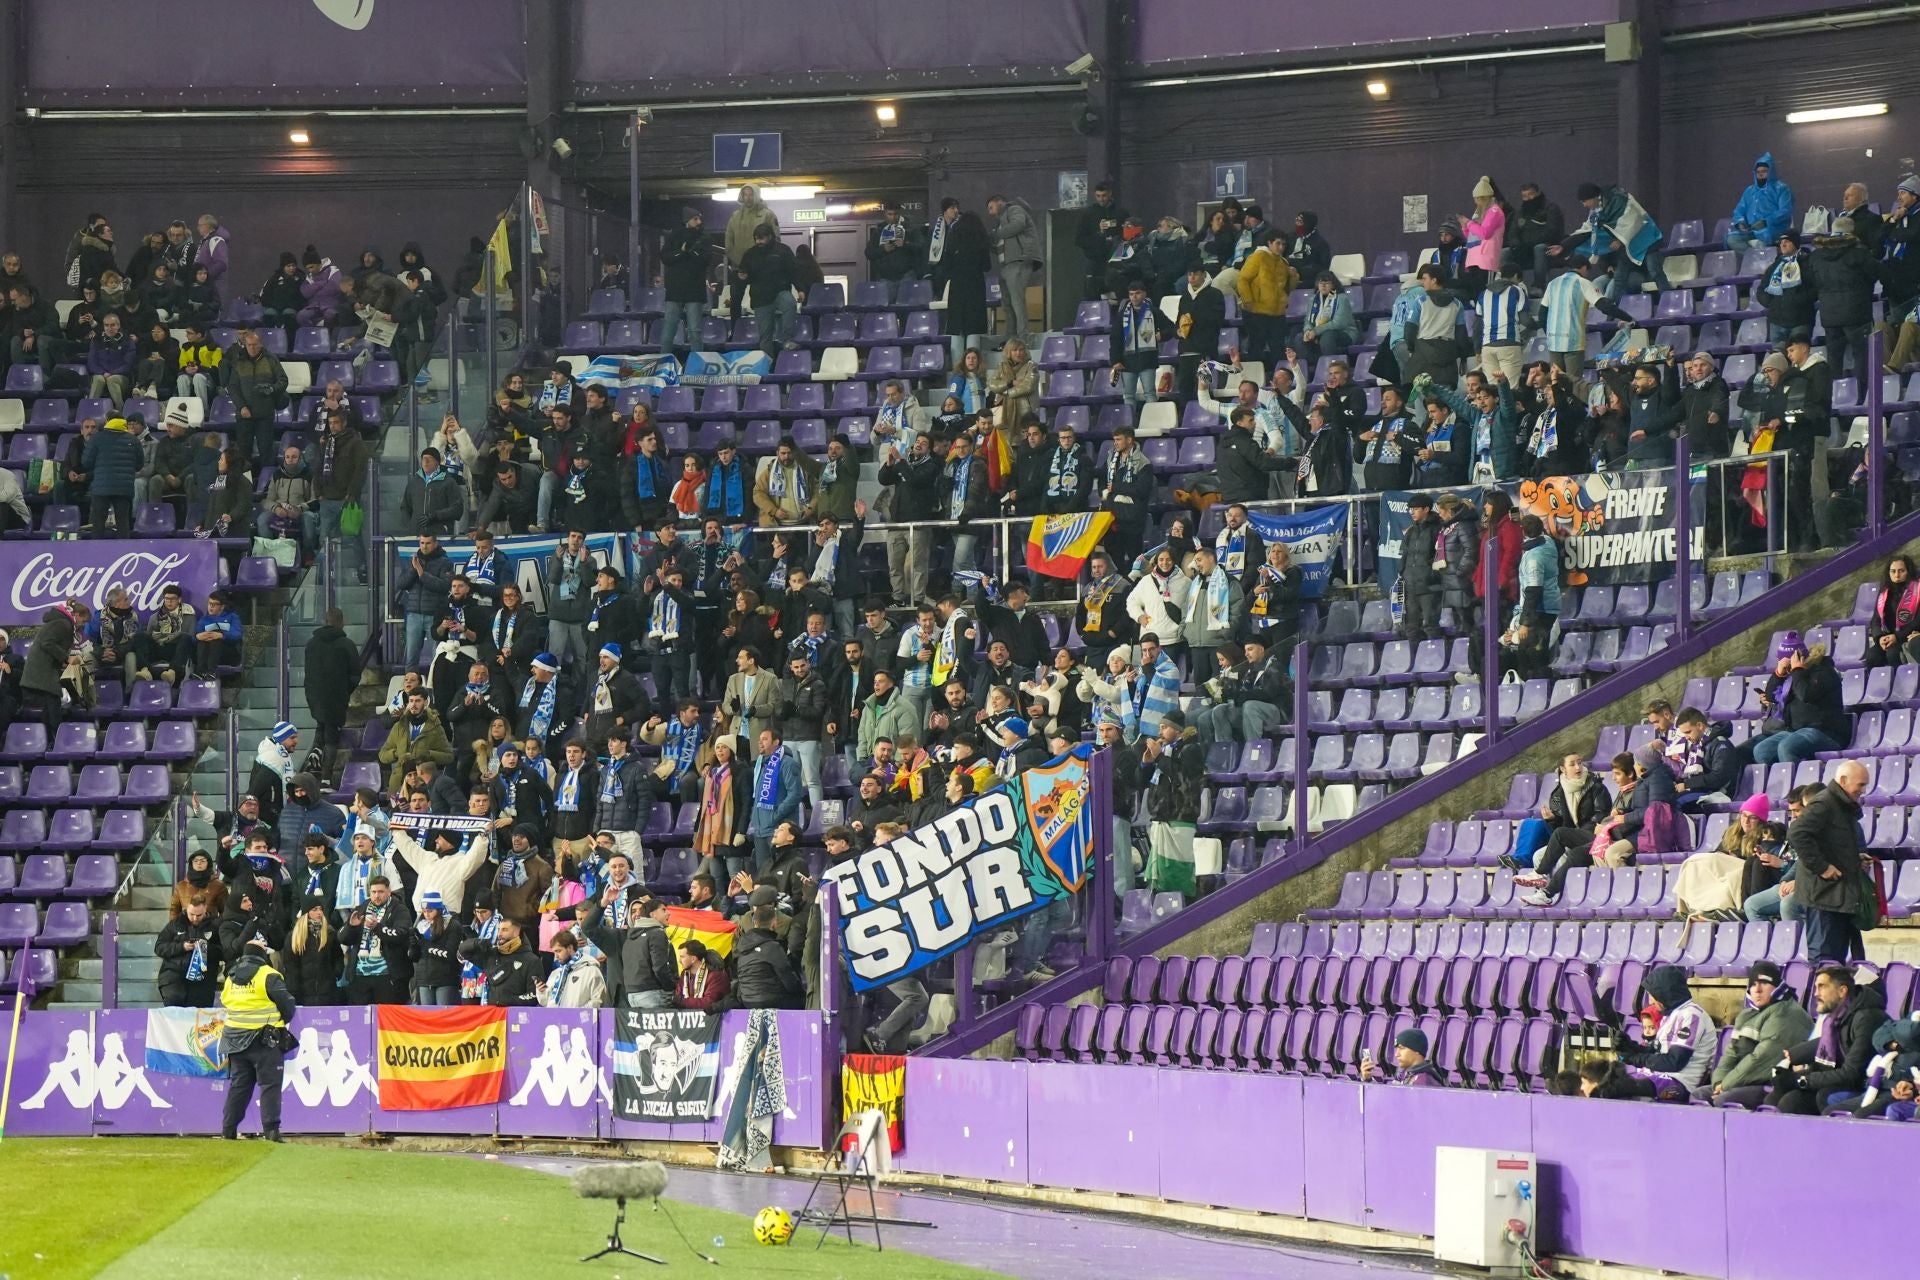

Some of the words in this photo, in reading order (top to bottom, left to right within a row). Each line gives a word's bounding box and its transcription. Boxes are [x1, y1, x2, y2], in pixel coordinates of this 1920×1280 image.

[740, 138, 755, 168] 7
[796, 211, 825, 221] SALIDA
[709, 375, 741, 385] PRESENTE
[1605, 486, 1668, 520] FRENTE
[1565, 526, 1704, 570] SUPERPANTEA
[391, 815, 417, 826] HIJOS
[418, 817, 431, 828] DE
[432, 818, 445, 828] LA
[823, 792, 1019, 917] FONDO
[844, 846, 1033, 980] SUR
[628, 1012, 640, 1028] EL
[642, 1012, 674, 1030] FARY
[678, 1010, 706, 1029] VIVE
[385, 1035, 500, 1068] GUADALMAR
[625, 1099, 639, 1114] LA
[642, 1100, 674, 1116] LUCHA
[676, 1101, 707, 1117] SIGUE
